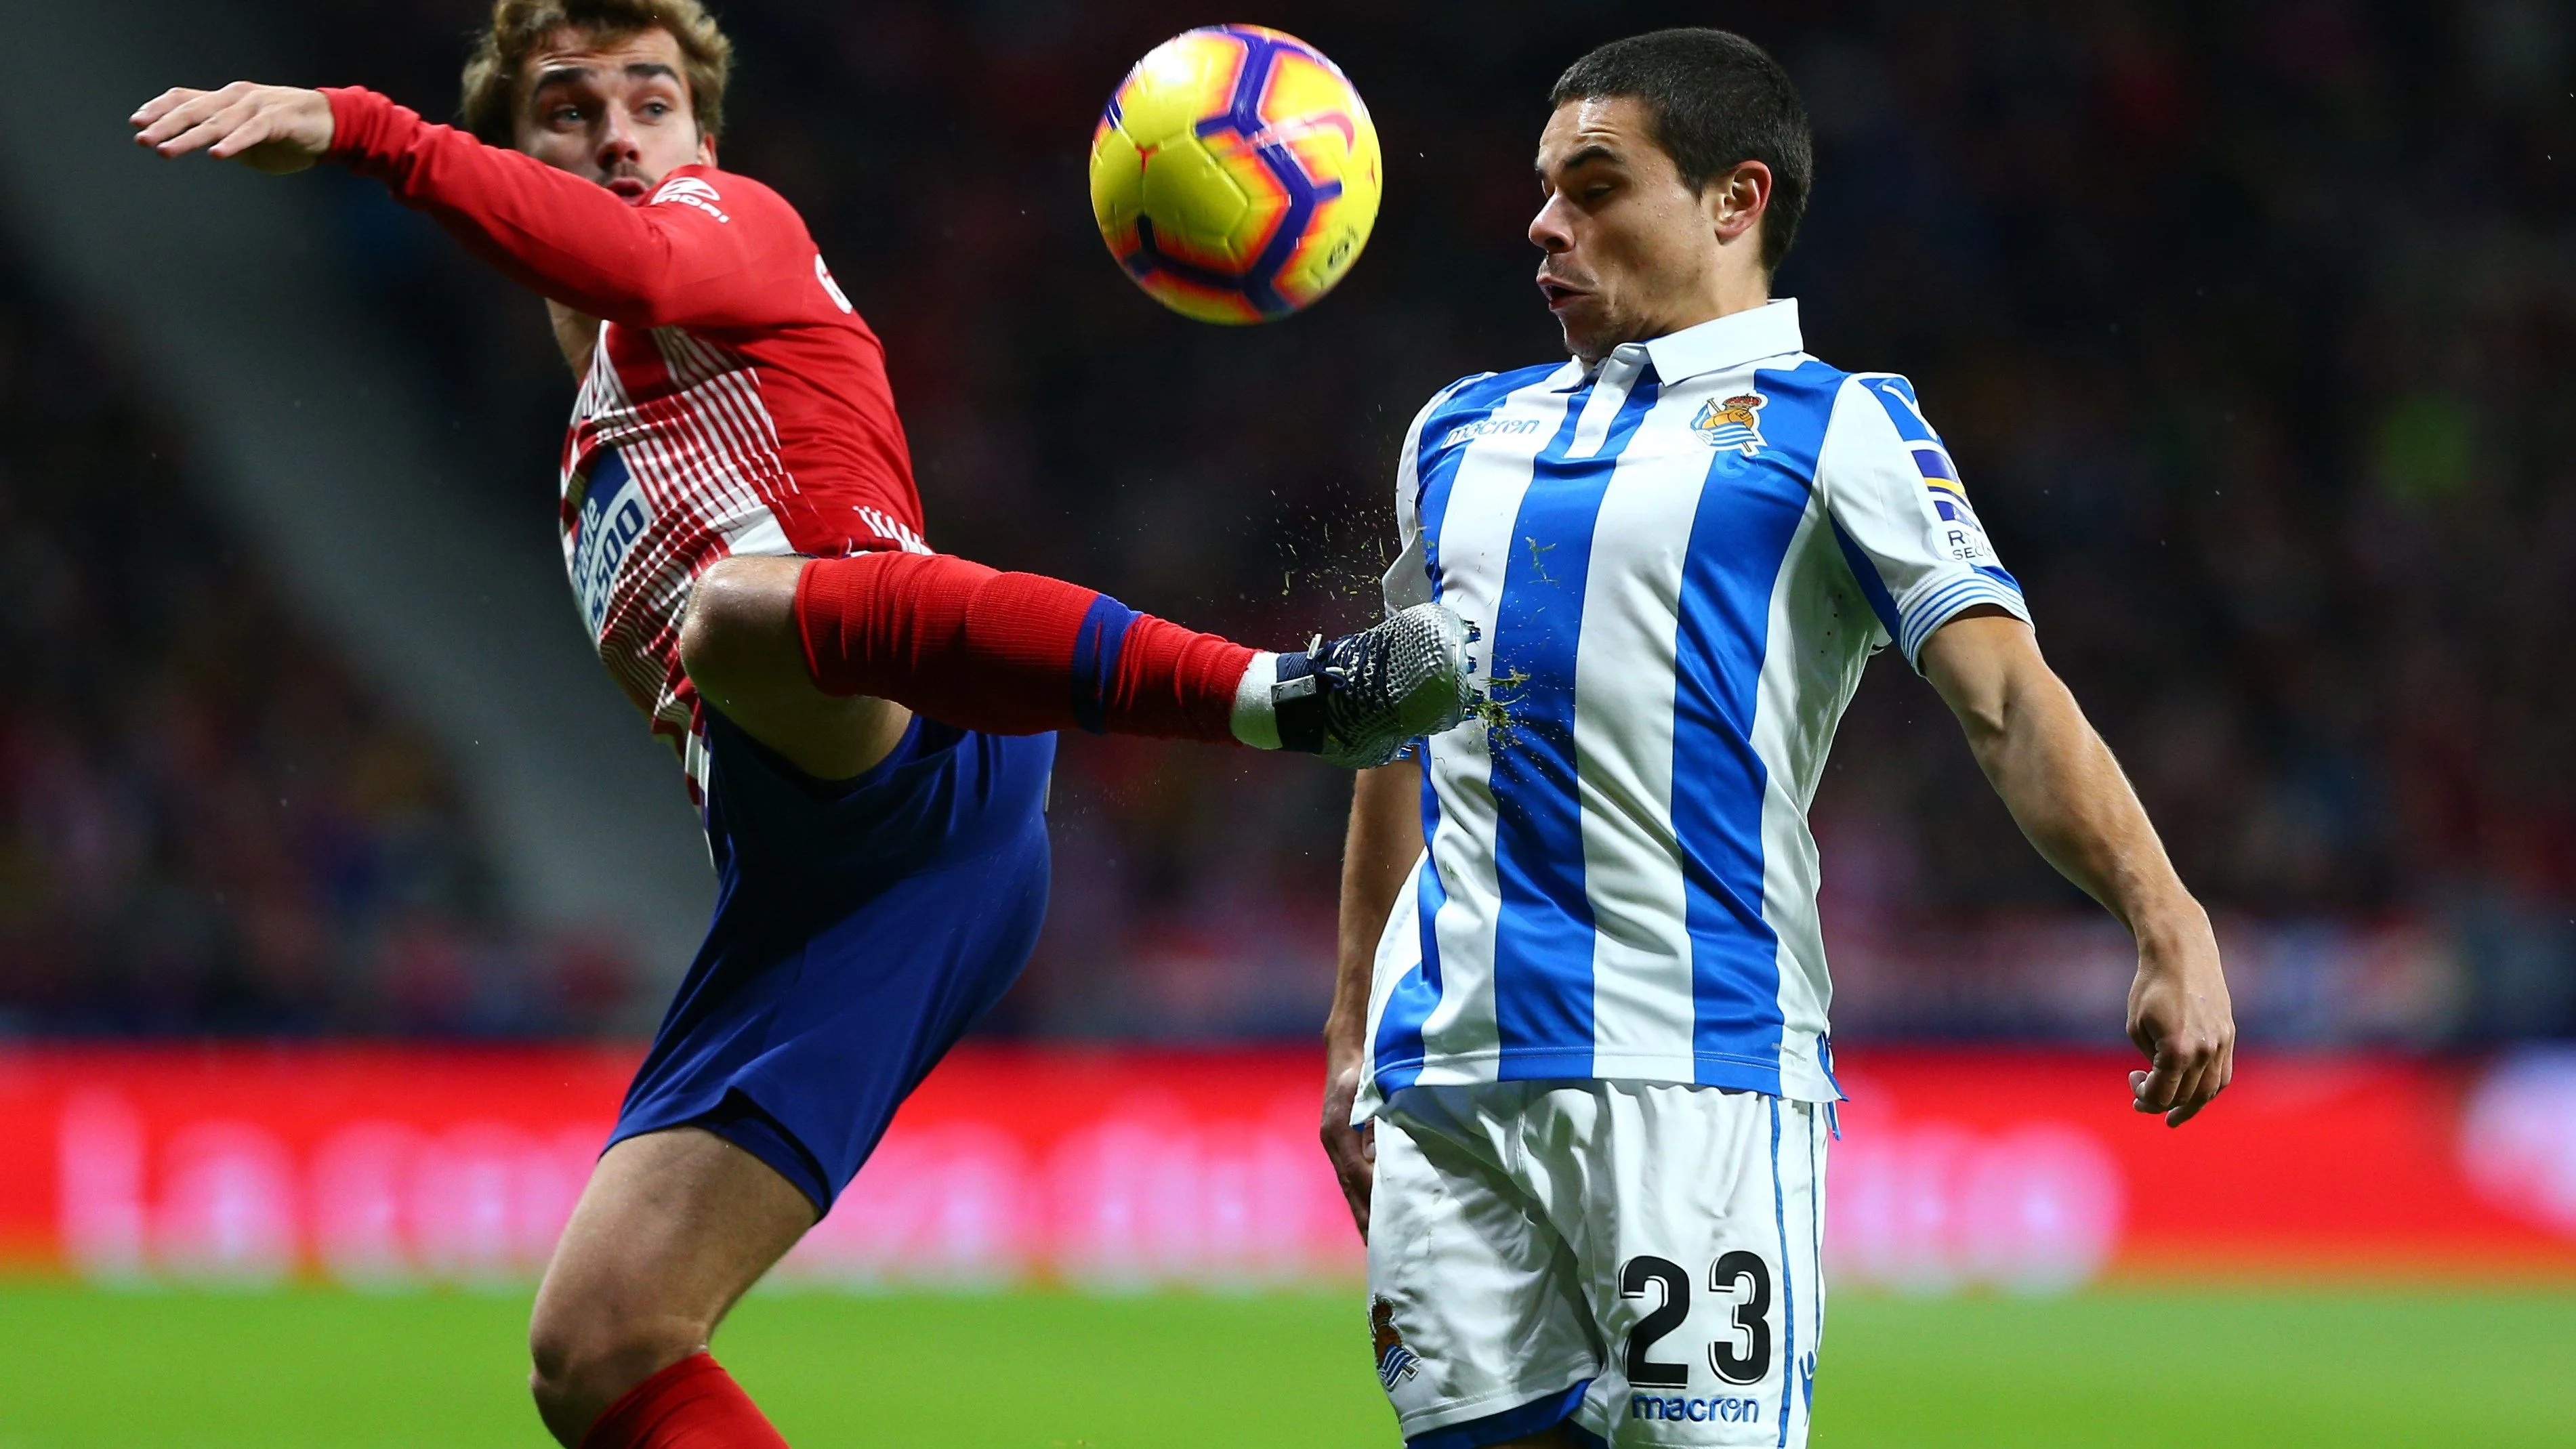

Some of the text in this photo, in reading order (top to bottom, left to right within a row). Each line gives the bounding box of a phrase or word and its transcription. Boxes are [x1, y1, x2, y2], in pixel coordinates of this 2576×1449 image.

[1441, 420, 1540, 448] macron
[574, 497, 602, 602] rade
[1618, 1251, 1771, 1389] 23
[1632, 1393, 1760, 1423] macron
